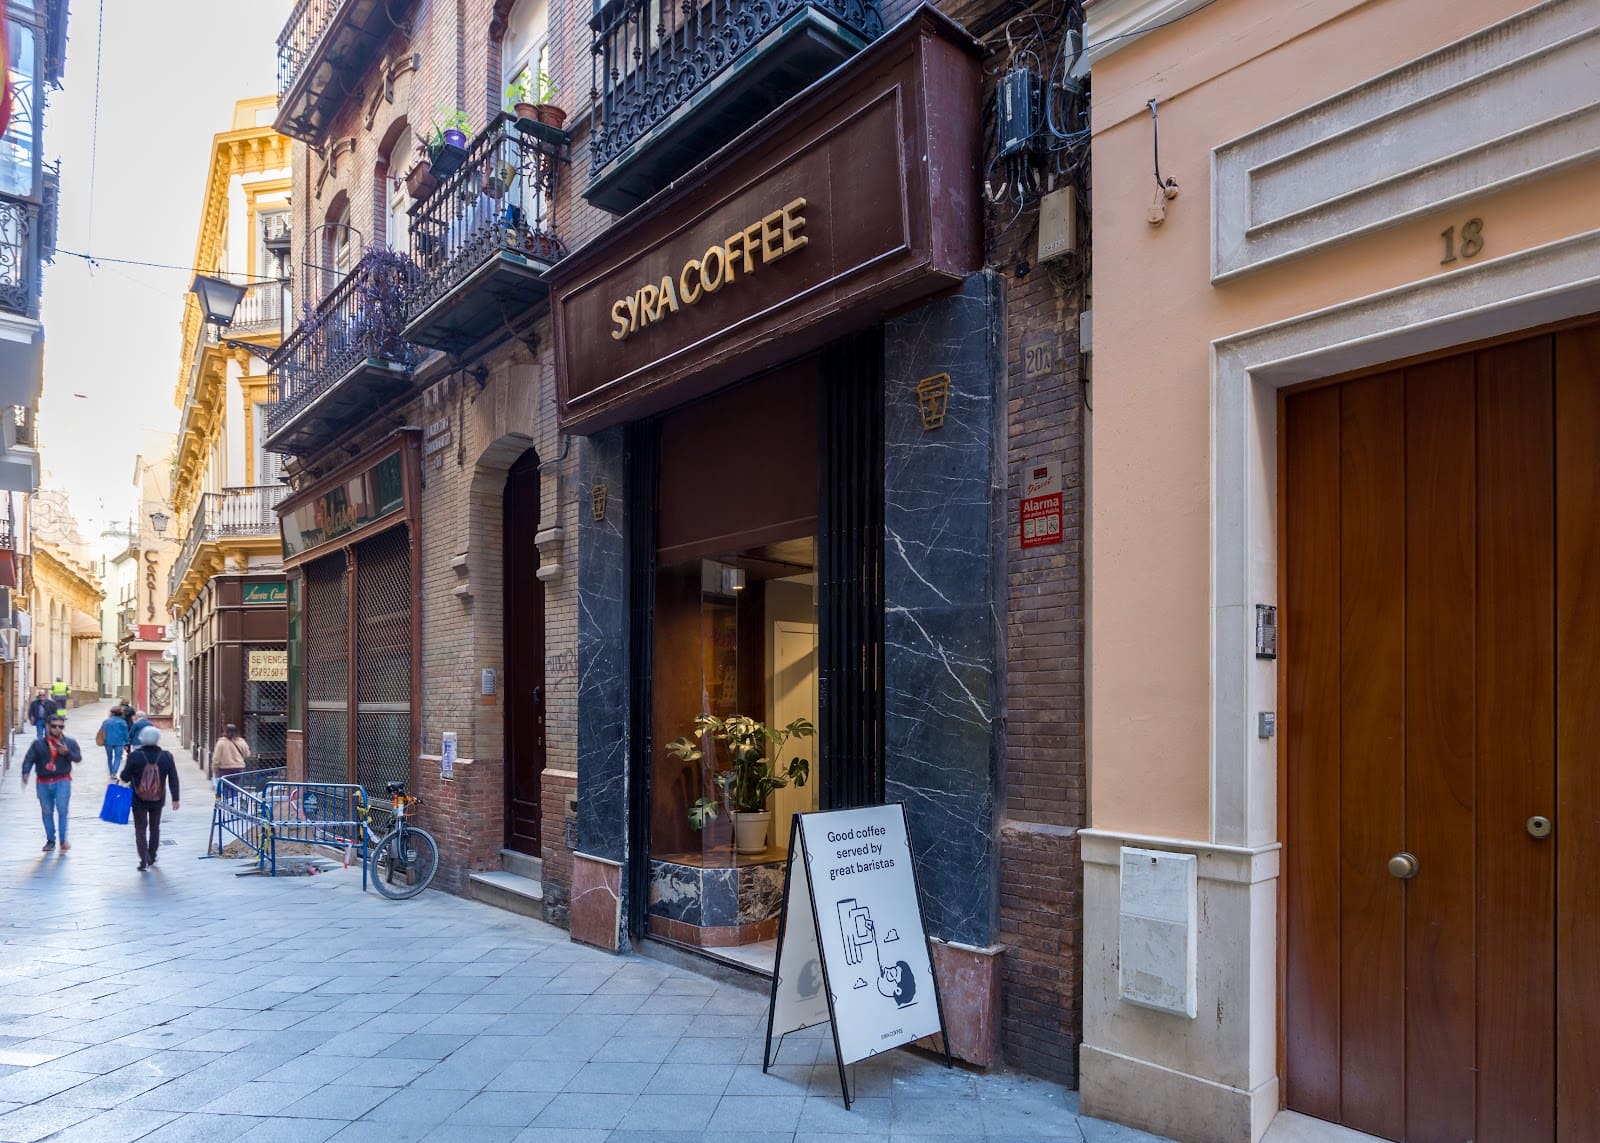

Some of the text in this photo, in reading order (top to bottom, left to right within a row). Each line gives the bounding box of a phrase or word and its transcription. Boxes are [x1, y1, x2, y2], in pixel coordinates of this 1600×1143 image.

[1440, 217, 1484, 265] 18
[610, 197, 809, 341] SYRA COFFEE
[1023, 498, 1059, 513] Alarma
[251, 655, 288, 664] SE VENDE
[827, 825, 886, 843] Good coffee
[836, 842, 882, 859] served by
[830, 859, 895, 881] great baristas
